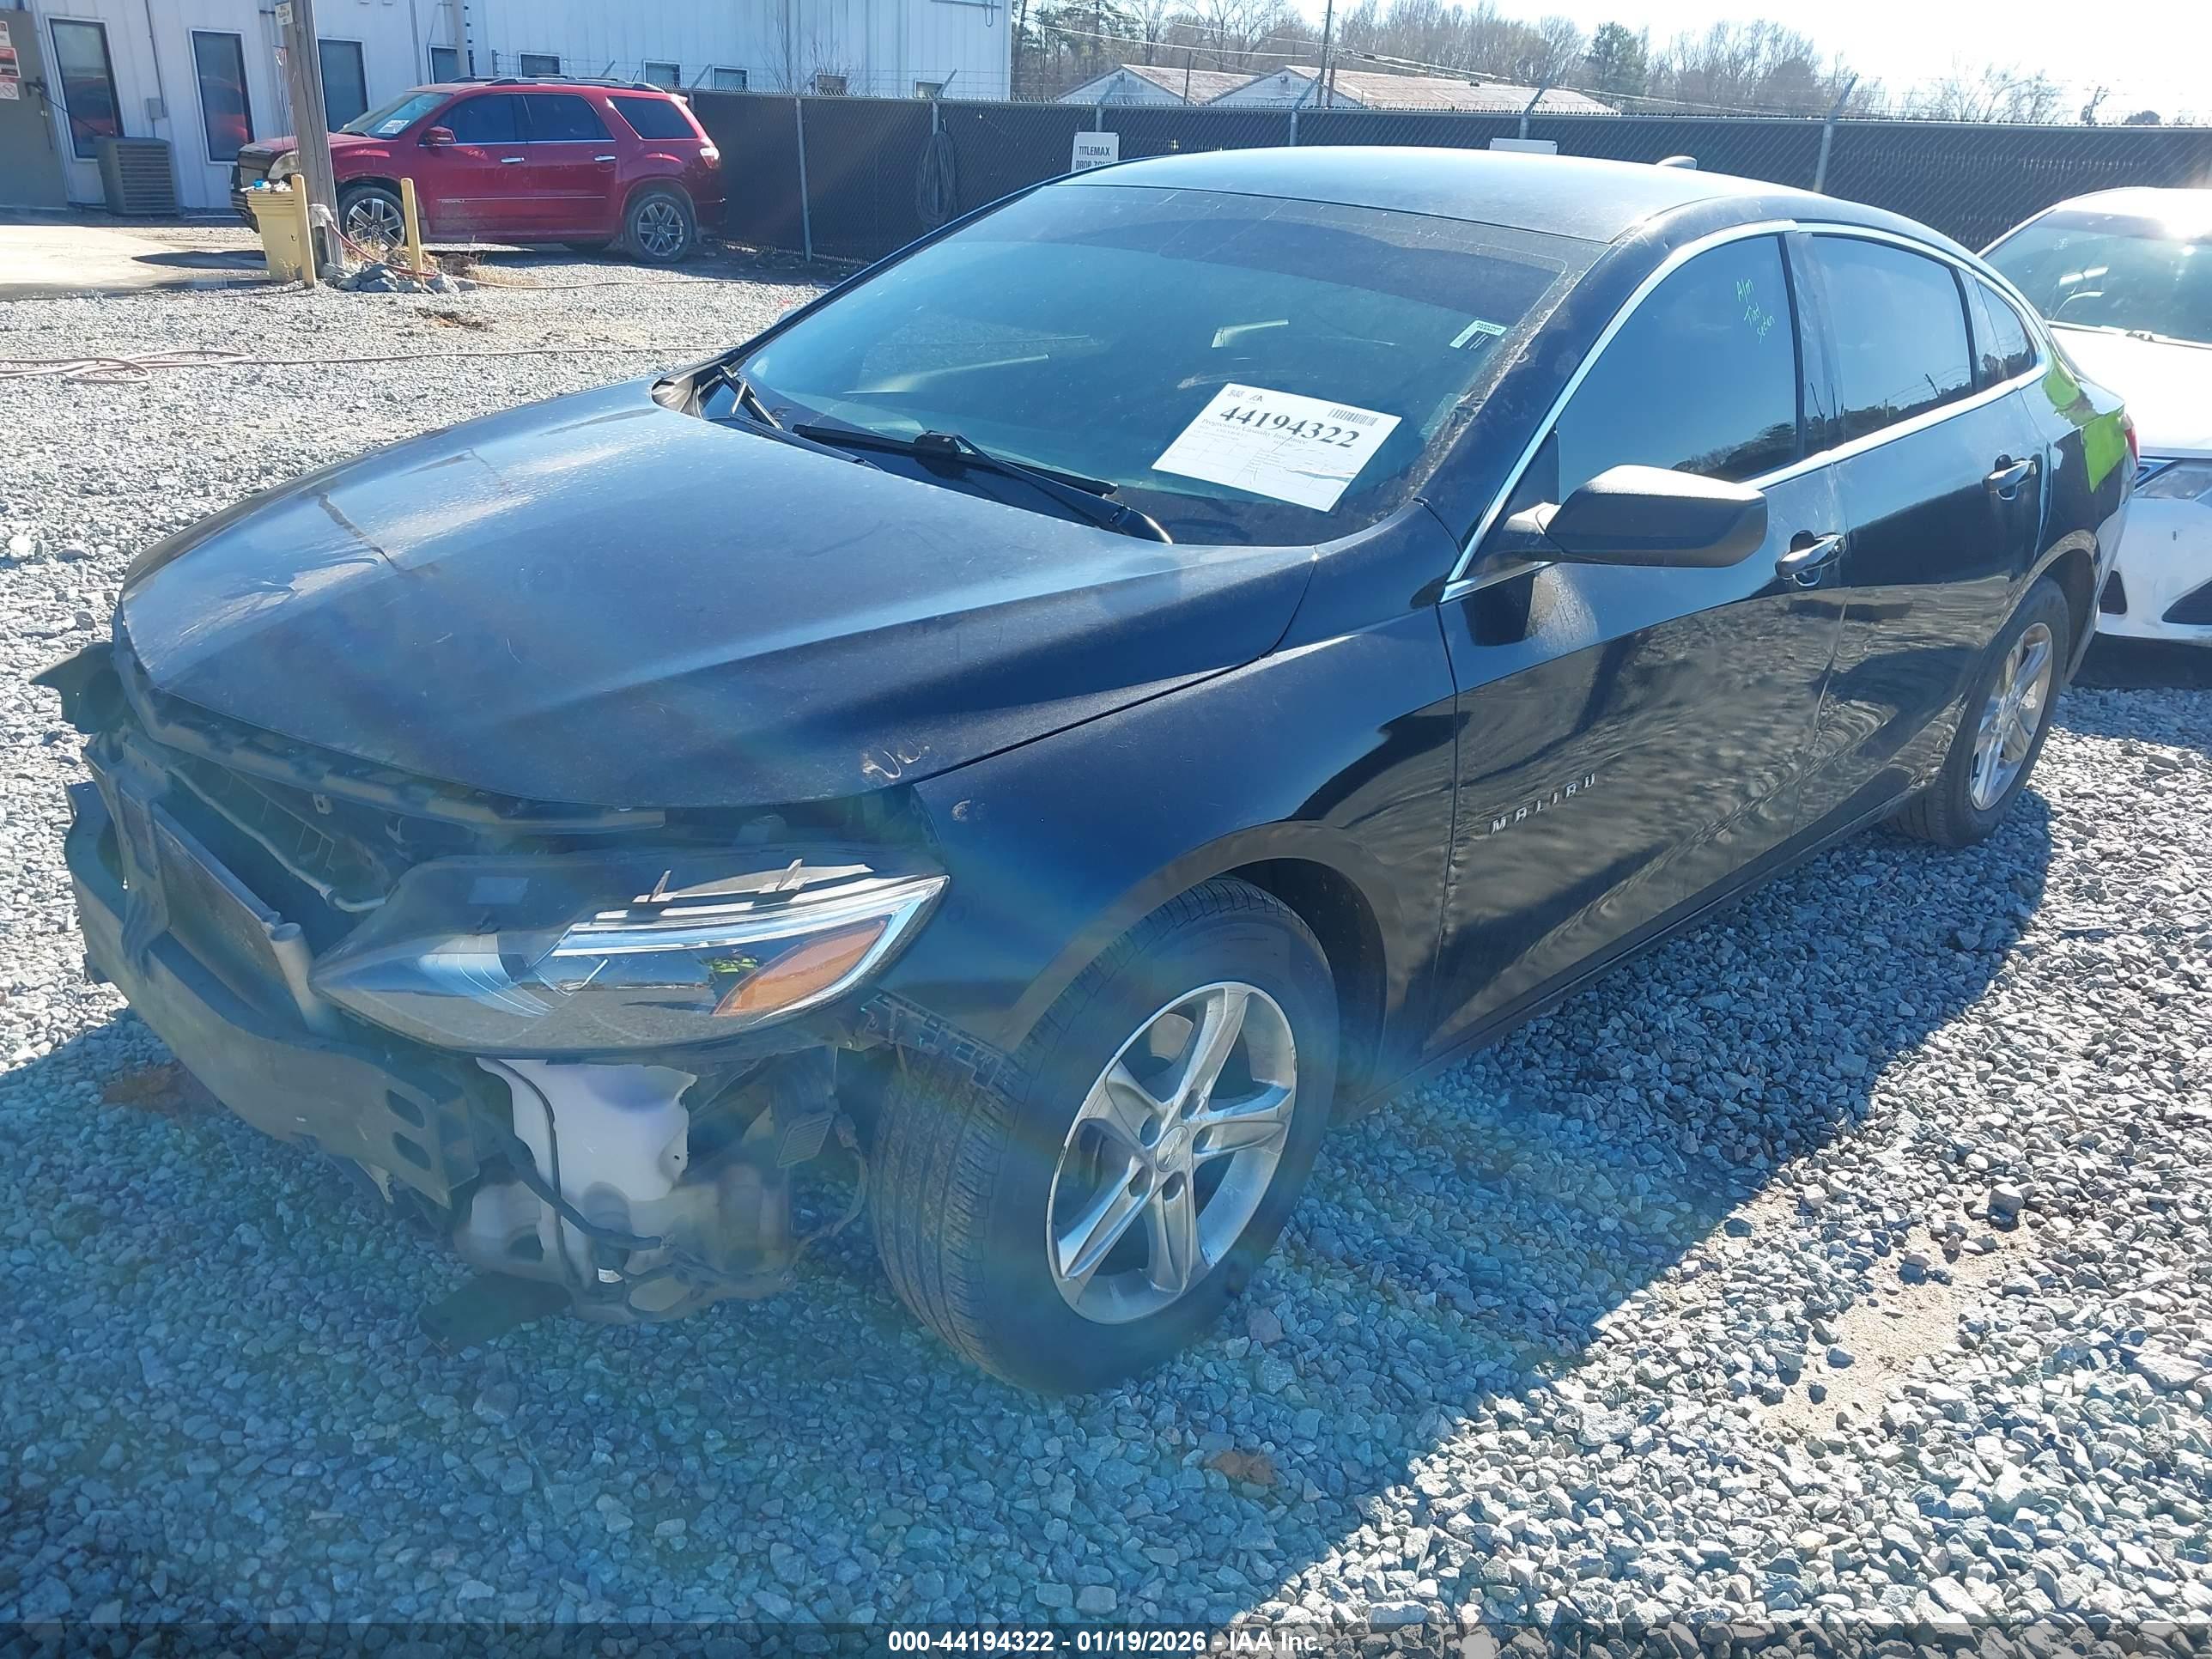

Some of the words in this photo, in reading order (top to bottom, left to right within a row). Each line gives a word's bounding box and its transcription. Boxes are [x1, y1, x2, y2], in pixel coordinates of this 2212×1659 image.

[1079, 145, 1111, 156] TITLEMAX
[1076, 160, 1092, 170] DROP
[1201, 418, 1242, 431] Progressive
[1242, 425, 1271, 437] Casualty
[1219, 405, 1360, 449] 44194322
[1491, 773, 1595, 835] MALIBU
